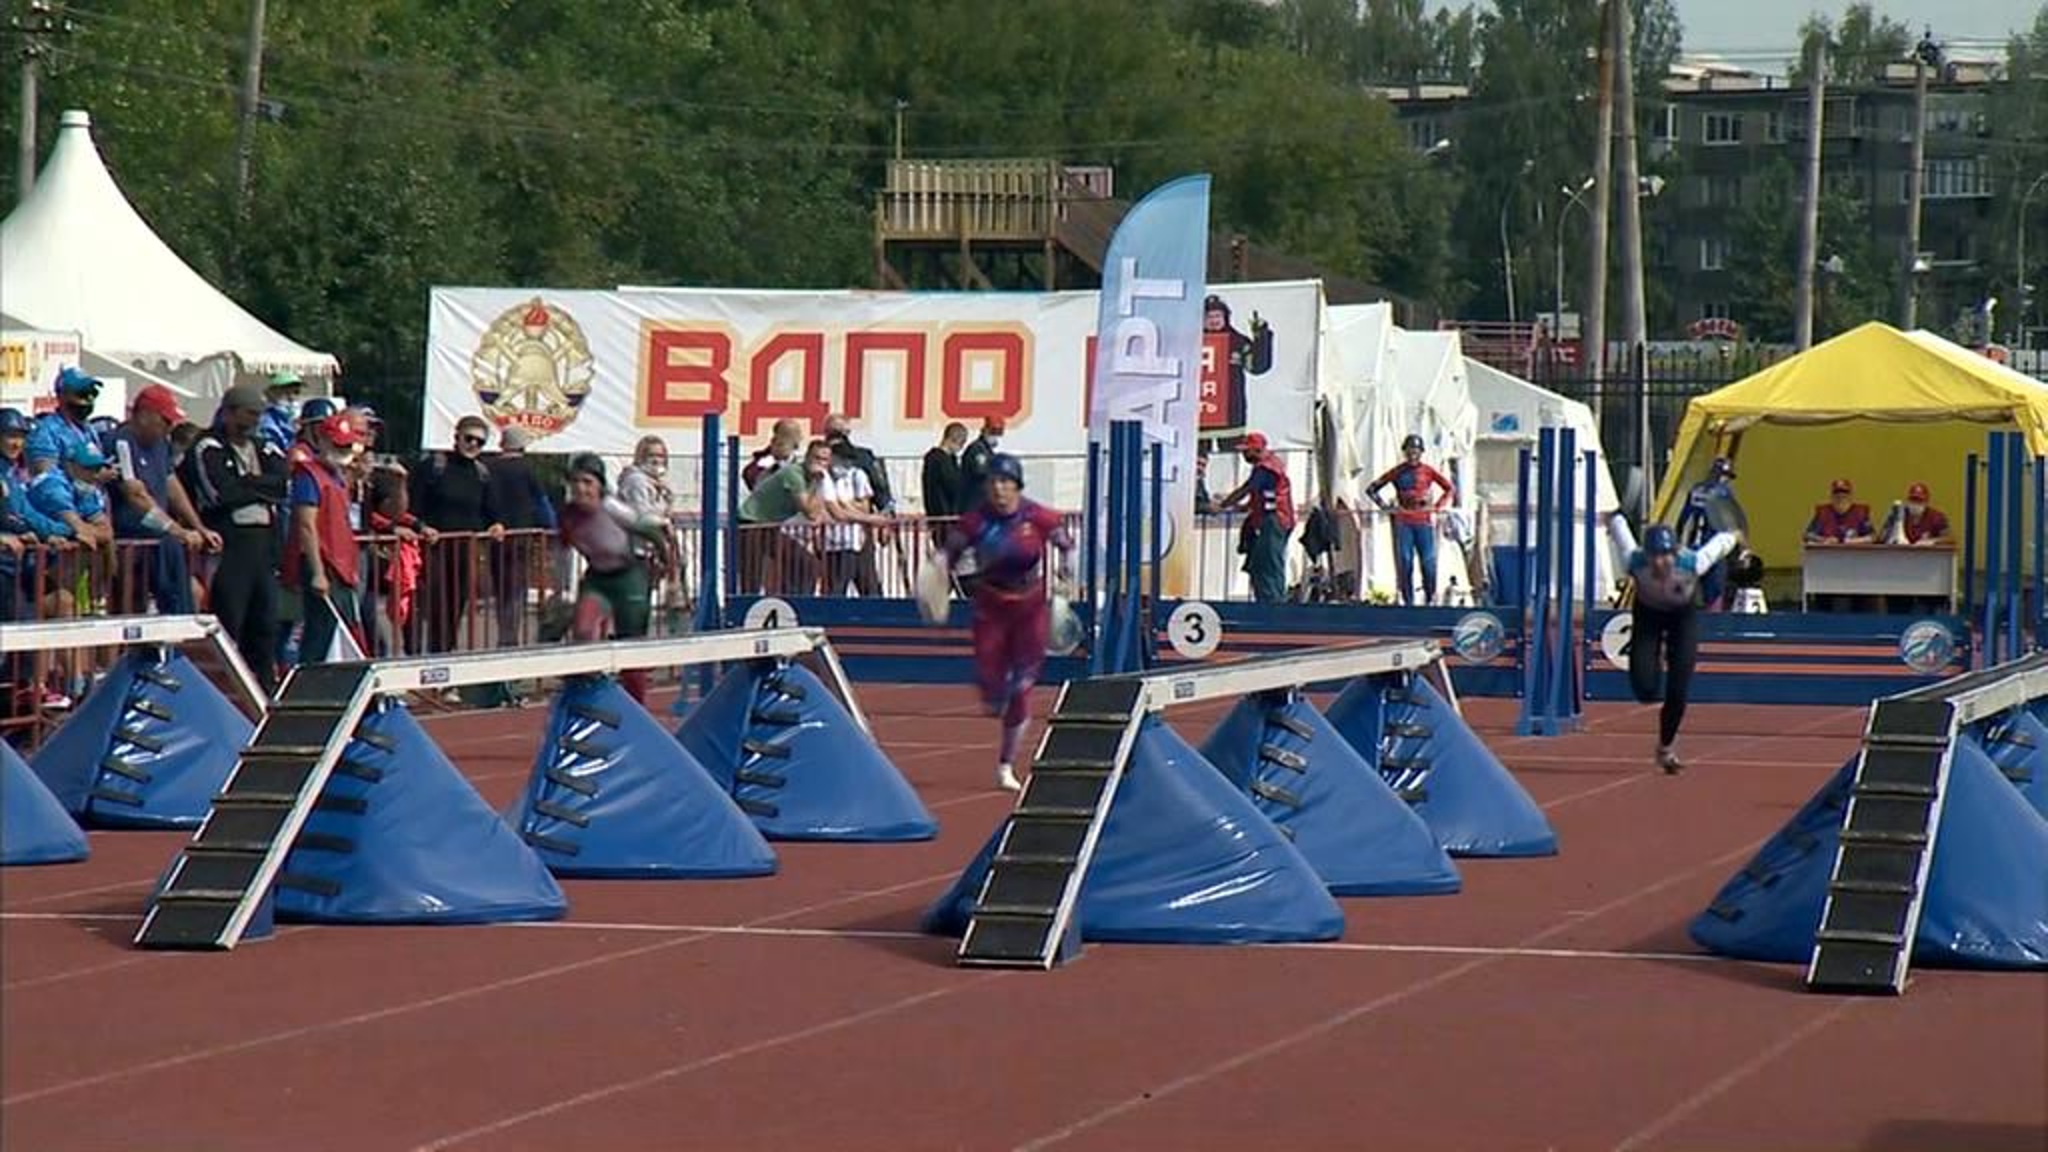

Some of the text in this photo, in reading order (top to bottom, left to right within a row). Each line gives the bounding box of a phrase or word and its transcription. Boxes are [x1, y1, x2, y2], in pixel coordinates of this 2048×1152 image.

[643, 329, 1026, 435] ВДПО
[762, 608, 778, 630] 4
[1184, 612, 1205, 644] 3
